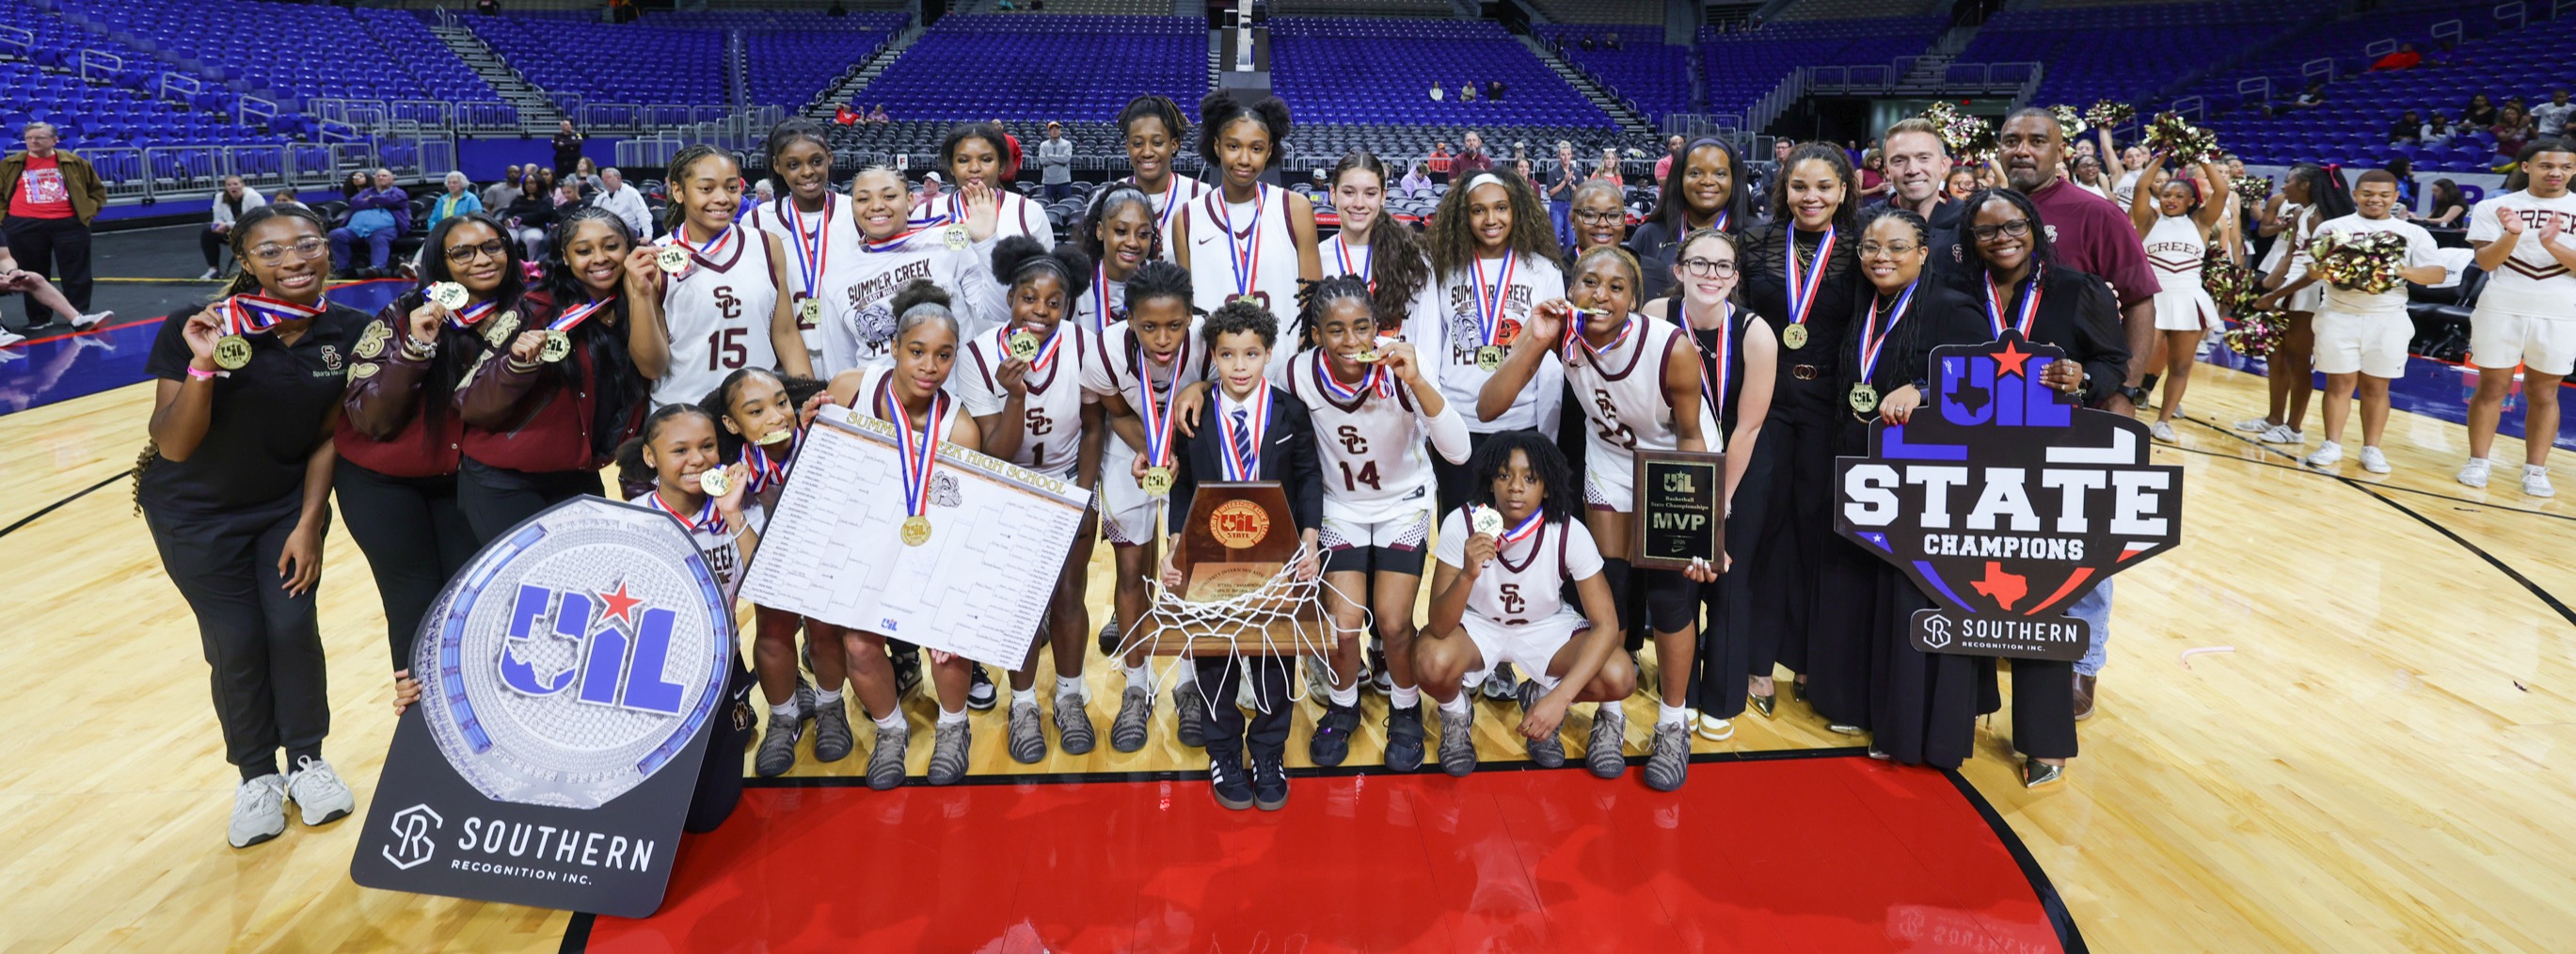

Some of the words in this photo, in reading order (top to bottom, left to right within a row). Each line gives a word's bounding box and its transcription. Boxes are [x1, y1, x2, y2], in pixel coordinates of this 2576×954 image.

[847, 271, 892, 306] SUMMER
[894, 258, 932, 283] CREEK
[1451, 284, 1495, 307] SUMR
[713, 285, 741, 319] SC
[708, 327, 748, 372] 15
[1941, 340, 2072, 427] UIL
[1026, 406, 1053, 436] SC
[847, 411, 897, 438] SUMM
[914, 434, 964, 460] CEEK
[964, 450, 1006, 474] HIGH
[1006, 466, 1066, 496] SCHOOL
[1031, 442, 1044, 467] 1
[1338, 425, 1368, 455] SC
[1339, 460, 1382, 491] 14
[1665, 502, 1709, 511] Championships
[1844, 464, 2170, 536] STATE
[1653, 512, 1706, 532] MVP
[1923, 533, 2085, 561] CHAMPIONS
[1500, 583, 1525, 614] SC
[498, 574, 686, 717] UIL
[1962, 618, 2077, 644] SOUTHERN
[1962, 641, 2024, 651] RECOGNITION
[457, 816, 655, 873] SOUTHERN
[451, 858, 557, 882] RECOGNITION
[563, 872, 593, 886] INC.
